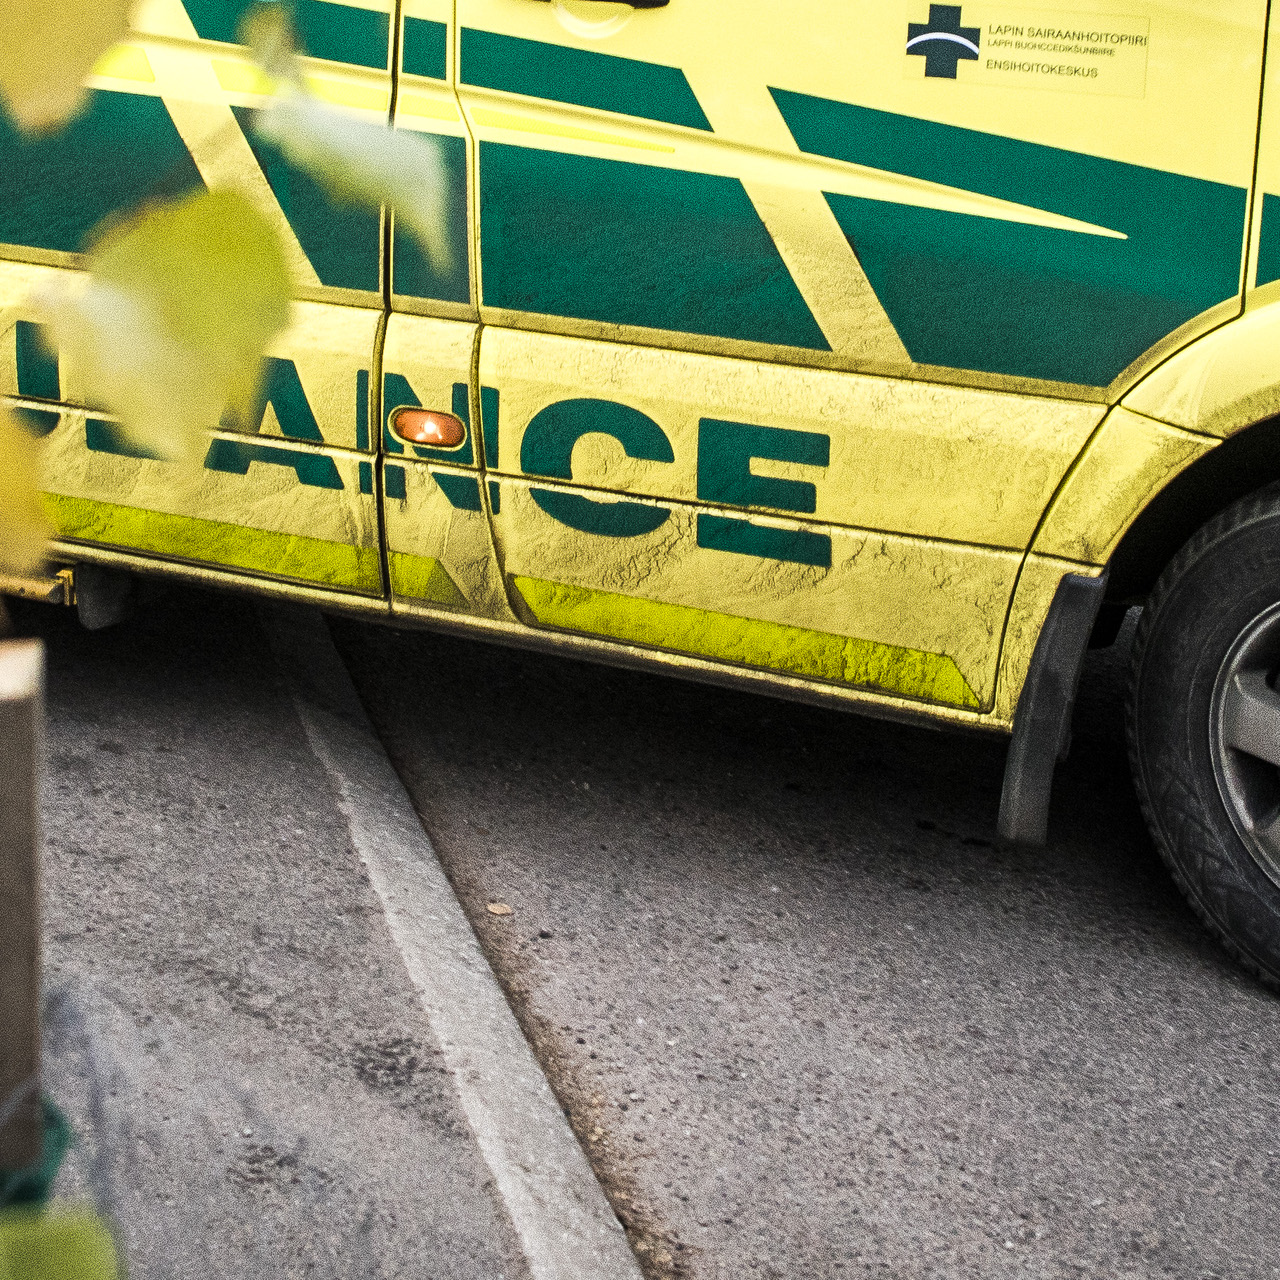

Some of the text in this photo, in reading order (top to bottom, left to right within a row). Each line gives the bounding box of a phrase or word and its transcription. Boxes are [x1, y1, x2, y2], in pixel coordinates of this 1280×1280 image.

[988, 24, 1148, 47] LAPIN SAIRAANHOITOPIIRI
[986, 58, 1099, 78] ENSIHOITOKESKUS
